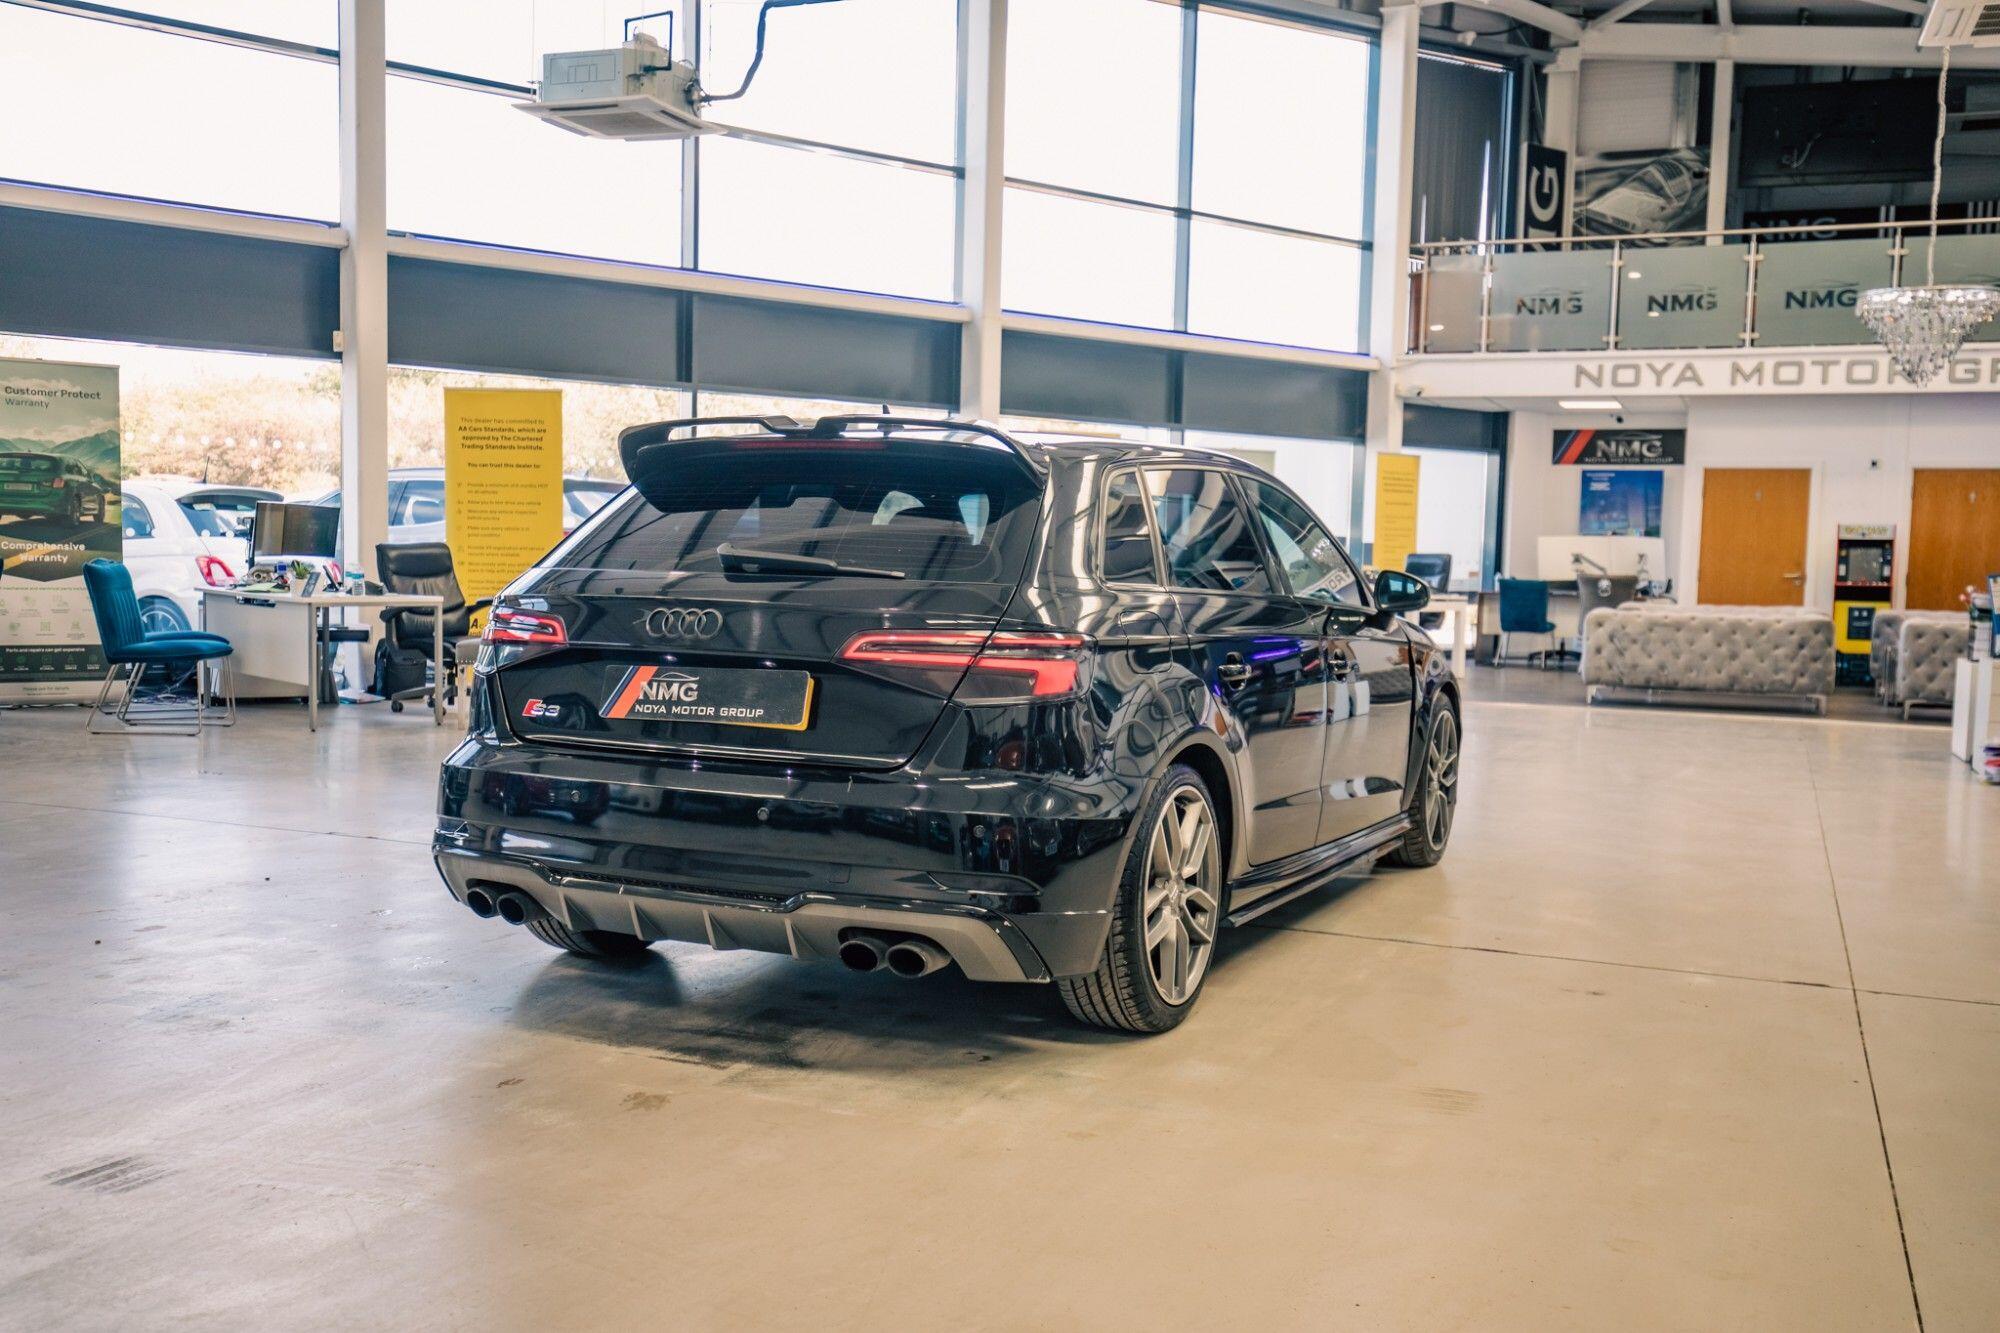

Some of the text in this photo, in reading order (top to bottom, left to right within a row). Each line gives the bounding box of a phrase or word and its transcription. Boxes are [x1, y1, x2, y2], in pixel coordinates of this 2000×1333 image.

[1516, 297, 1583, 315] NMG
[1647, 293, 1718, 312] NMG
[1785, 289, 1858, 310] NMG
[1575, 362, 1704, 388] NOYA
[4, 386, 102, 400] Customer Protect
[5, 398, 50, 409] Warranty
[1596, 440, 1663, 458] NMG
[1, 541, 86, 551] Comprehensive
[20, 553, 69, 564] Warranty
[638, 681, 700, 702] NMG
[530, 702, 561, 717] S3
[634, 704, 764, 718] NOYA MOTOR GROUP
